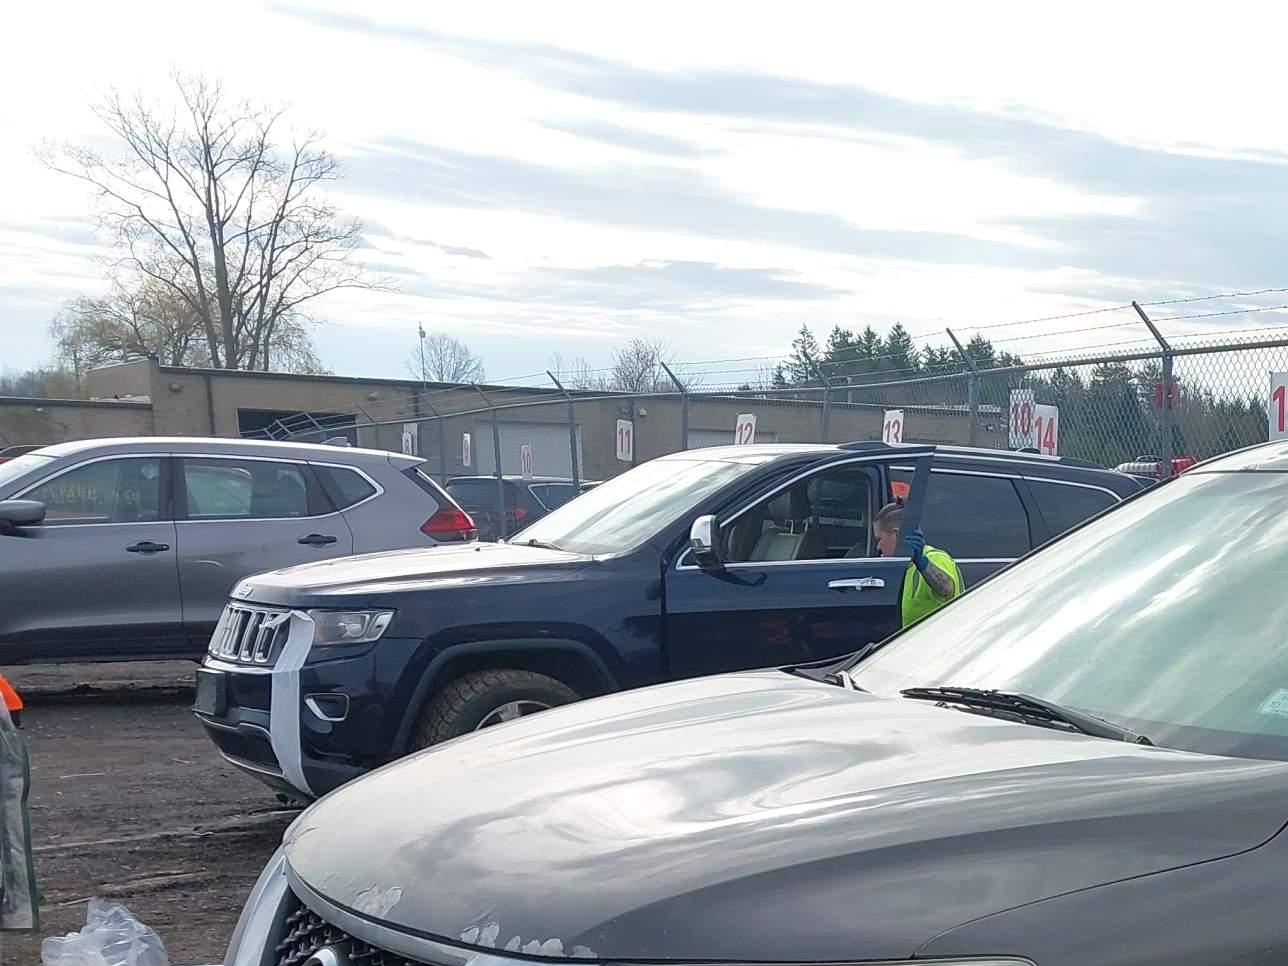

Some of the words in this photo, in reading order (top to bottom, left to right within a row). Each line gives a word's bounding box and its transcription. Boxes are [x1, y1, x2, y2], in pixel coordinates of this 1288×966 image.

[618, 427, 631, 454] 11
[737, 422, 753, 444] 12
[884, 419, 901, 443] 13
[1035, 416, 1056, 454] 14
